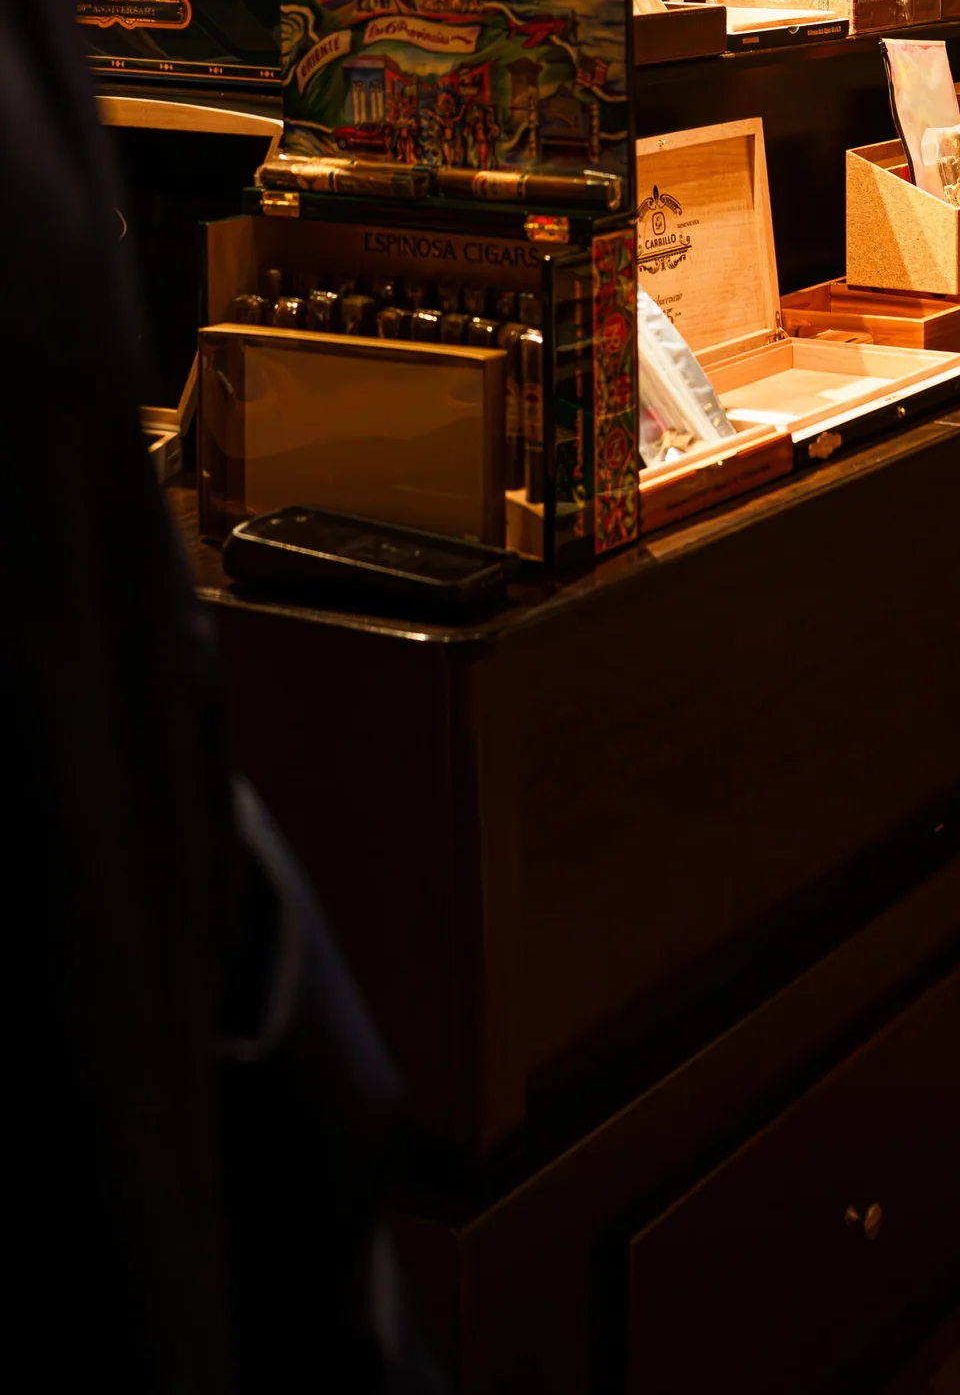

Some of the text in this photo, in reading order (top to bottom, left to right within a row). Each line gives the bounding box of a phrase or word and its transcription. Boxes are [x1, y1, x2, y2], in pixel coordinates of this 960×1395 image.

[92, 4, 157, 16] ANNIVERSARY
[645, 234, 677, 249] CARRILLO
[364, 232, 541, 270] ESPINOSA CIGARS
